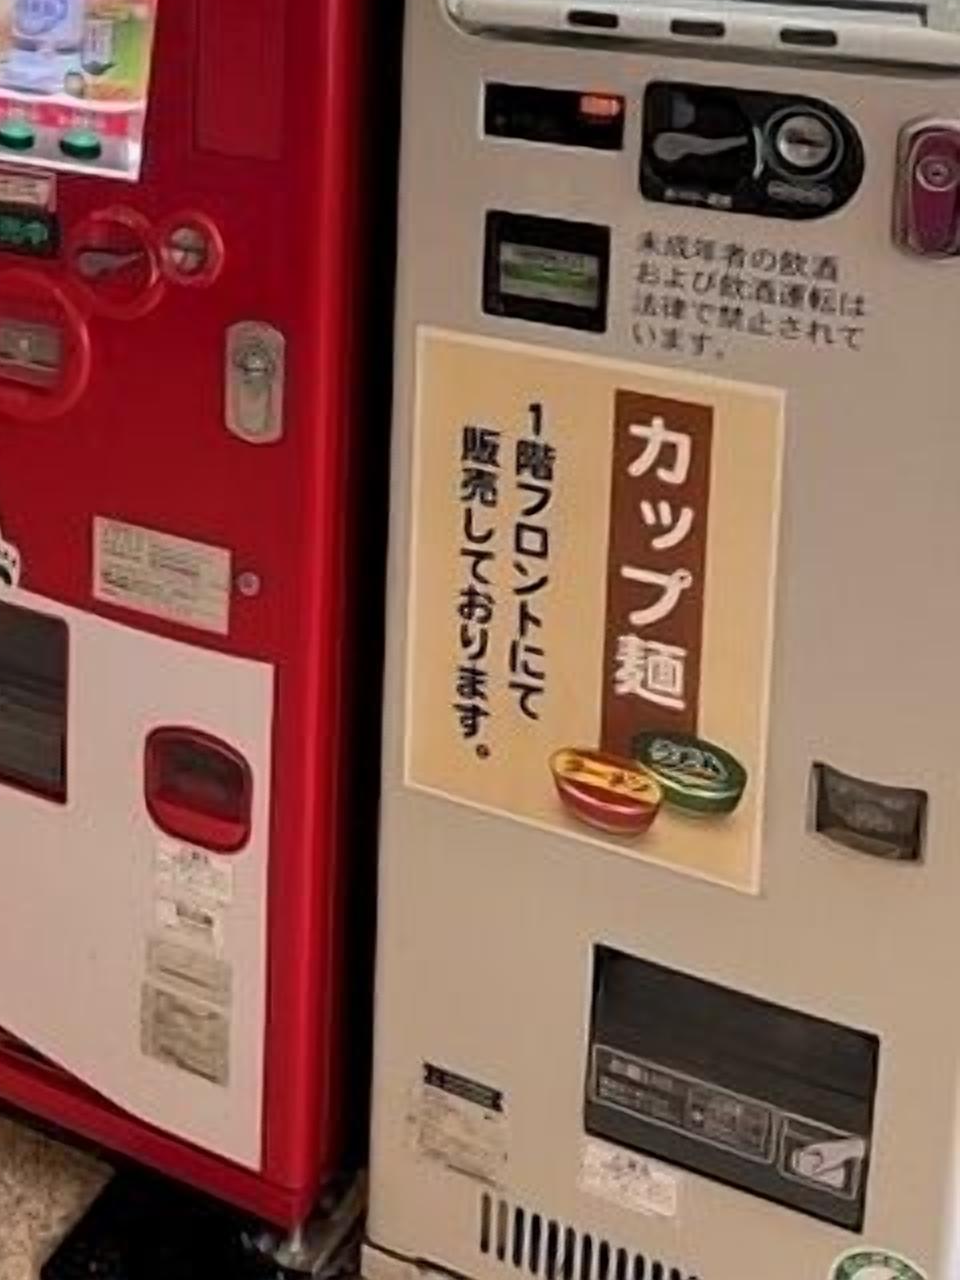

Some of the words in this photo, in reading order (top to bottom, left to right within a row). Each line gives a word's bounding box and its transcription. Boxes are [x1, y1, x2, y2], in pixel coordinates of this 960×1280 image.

[453, 425, 502, 761] 販売しております。
[507, 402, 557, 722] 1階フロントにて
[613, 415, 696, 712] カップ麺
